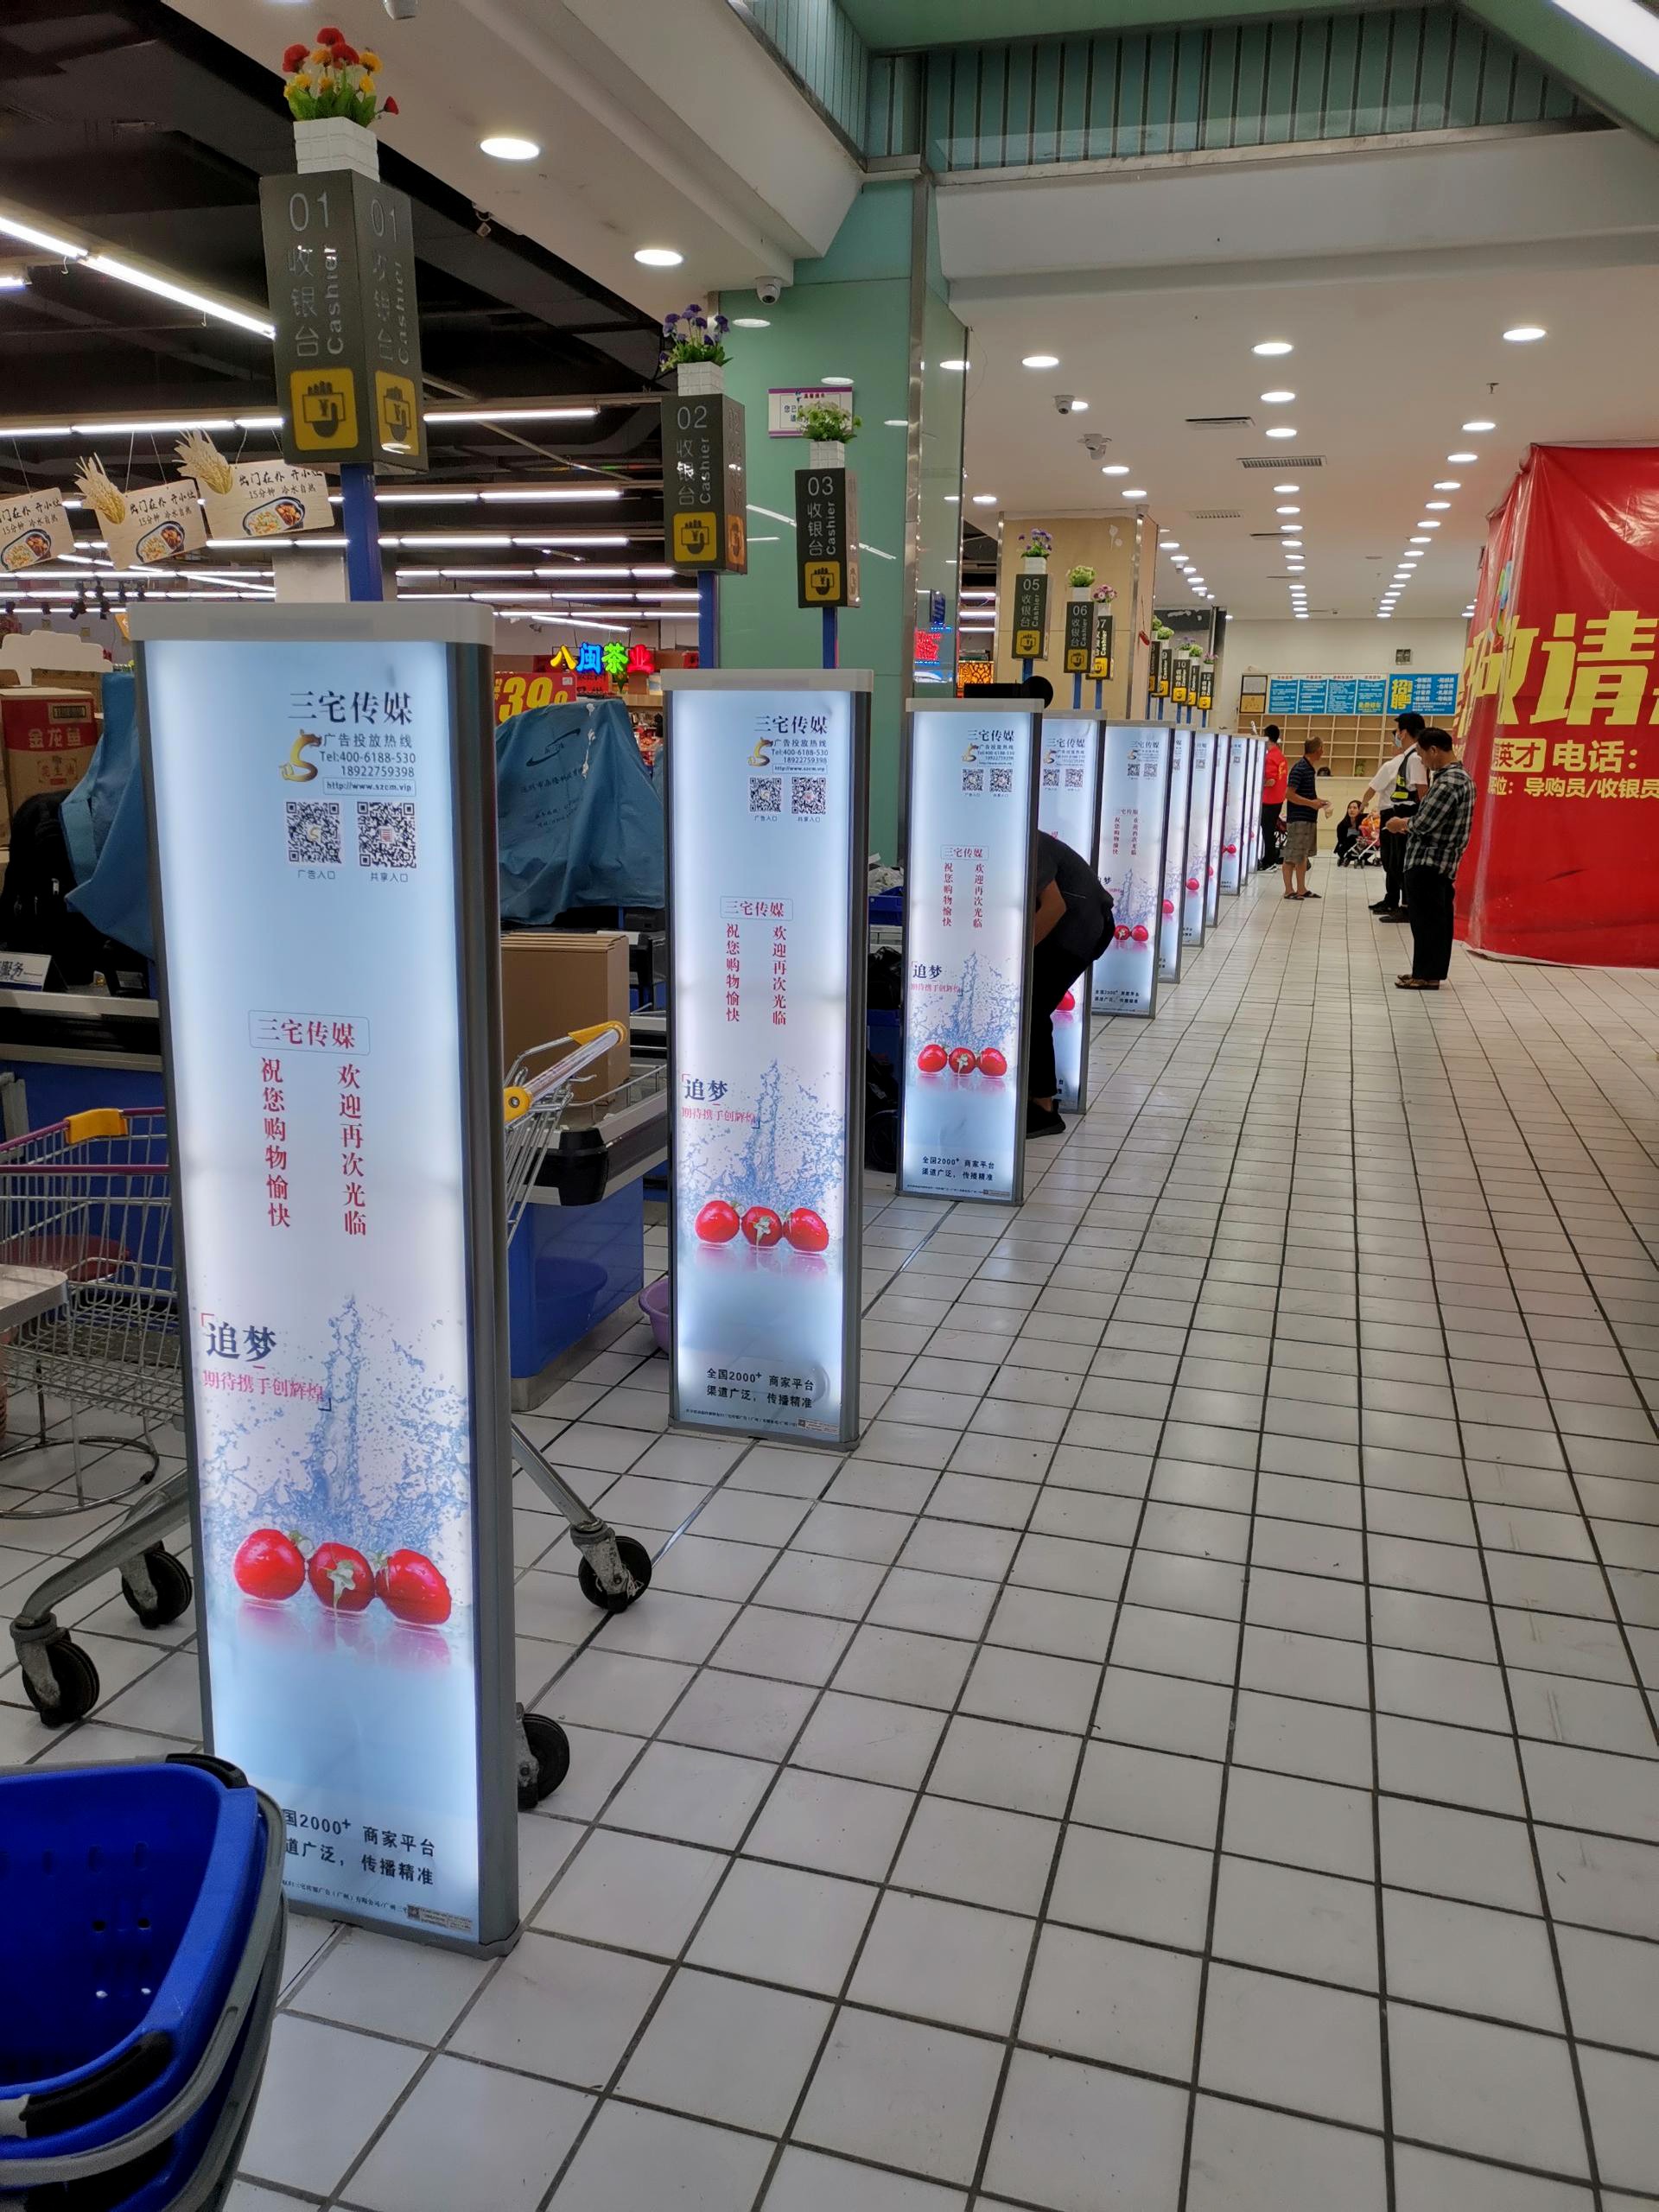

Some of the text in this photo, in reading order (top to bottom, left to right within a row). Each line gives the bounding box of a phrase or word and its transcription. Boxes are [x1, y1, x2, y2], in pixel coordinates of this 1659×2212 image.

[289, 189, 329, 232] 01
[371, 199, 397, 243] 01
[288, 245, 319, 357] 收银台
[324, 245, 343, 355] Cashier
[677, 405, 708, 429] 02
[677, 439, 695, 505] 收银台
[700, 438, 711, 505] Cashier
[249, 482, 316, 499] 15分钟 冷水自热
[808, 476, 834, 496] 03
[2, 521, 24, 536] 15分钟
[138, 513, 162, 527] 15分钟
[808, 502, 823, 556] 收银台
[826, 501, 836, 555] Cashier
[1023, 579, 1039, 591] 05
[1073, 605, 1087, 616] 06
[550, 641, 655, 675] 八闽茶业
[288, 690, 414, 725] 三宅传媒
[754, 715, 828, 734] 三宅传媒
[968, 729, 1014, 742] 三宅传媒
[29, 728, 81, 749] 金龙鱼
[323, 734, 412, 748] 广告投放热线
[320, 751, 416, 763] Tel:400-6188-530
[341, 766, 415, 778] 18922759398
[944, 848, 983, 858] 三宅传媒
[297, 869, 335, 880] 广告入口
[371, 872, 408, 883] 共享入口
[724, 900, 785, 918] 三宅传媒
[726, 923, 740, 1022] 祝您购物愉快
[772, 926, 787, 1026] 欢迎再次光临
[912, 963, 943, 979] 追梦
[257, 1018, 356, 1050] 三宅传媒
[684, 1078, 728, 1102] 追梦
[260, 1056, 290, 1228] 祝您购物愉快
[338, 1064, 366, 1236] 欢迎再次光临
[206, 1321, 277, 1363] 追梦
[202, 1370, 326, 1403] 期待携手创辉煌
[769, 1375, 814, 1391] 商家平台
[766, 1393, 812, 1408] 传播精准
[363, 1826, 435, 1857] 商家平台
[286, 1839, 434, 1885] 道广泛， 传播精准
